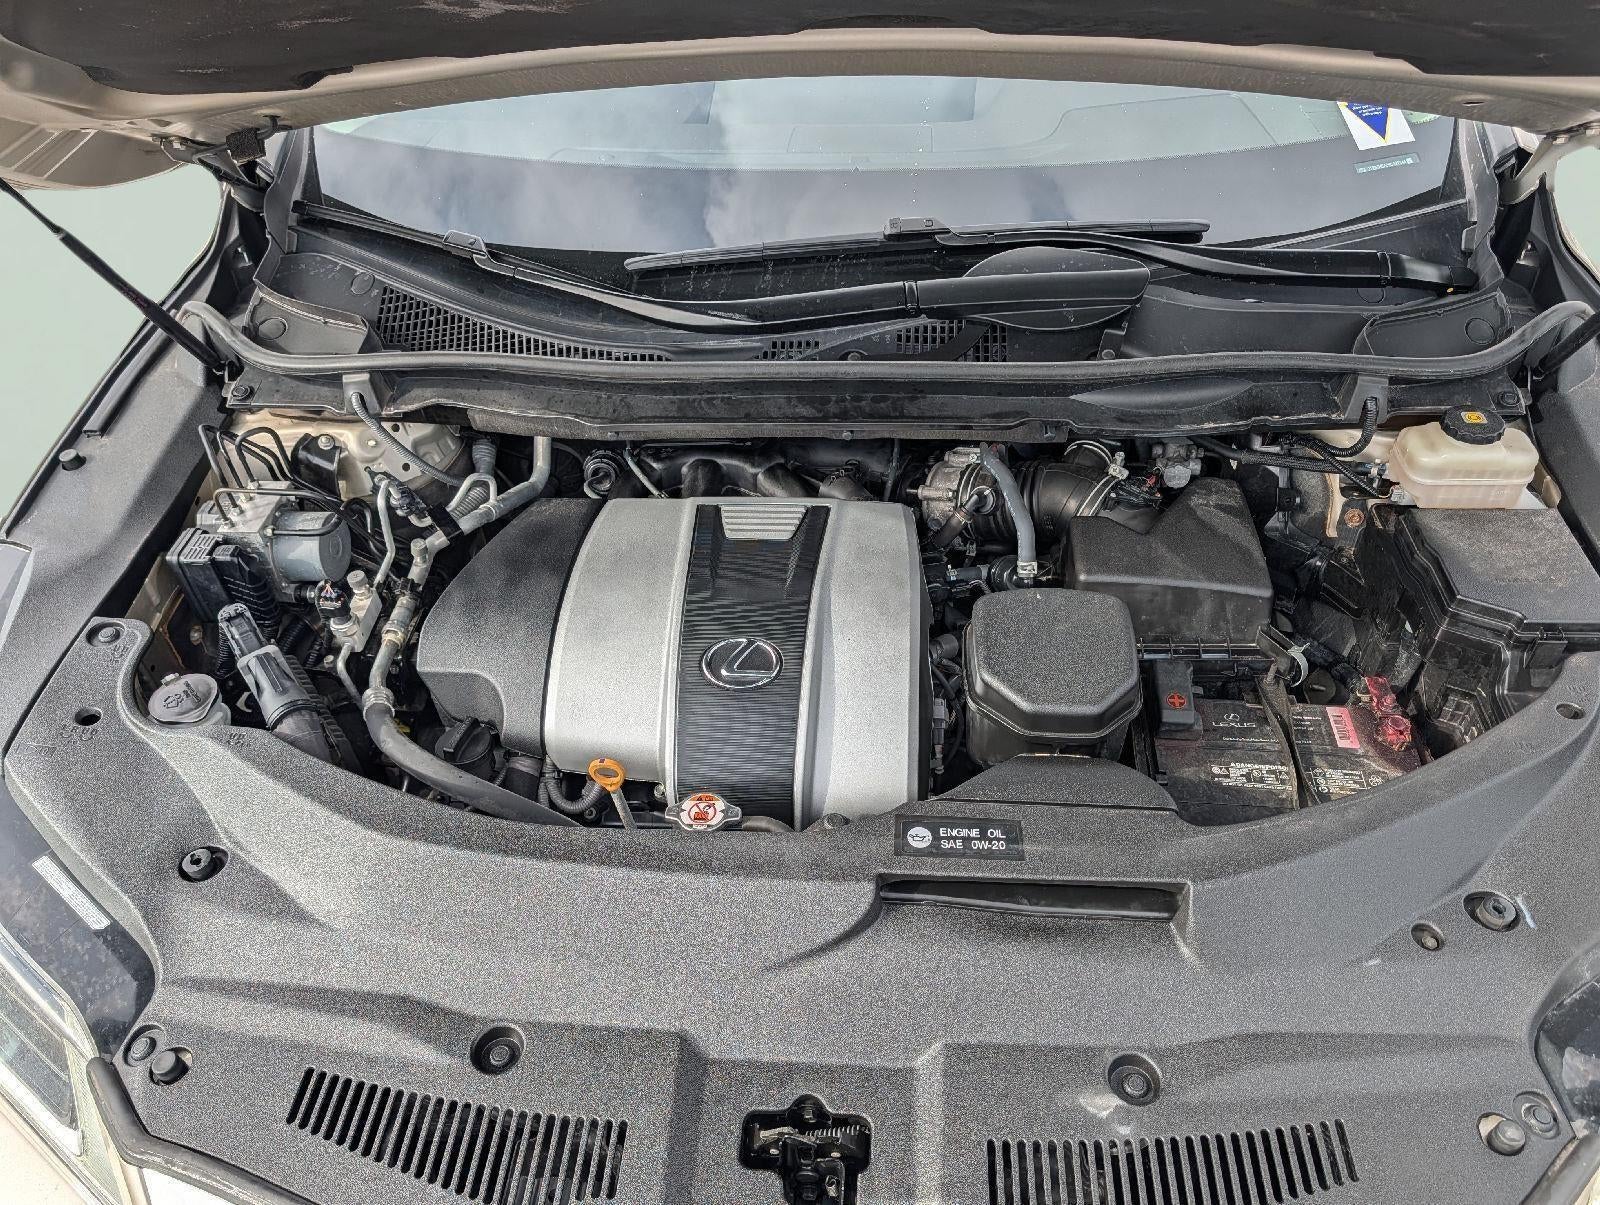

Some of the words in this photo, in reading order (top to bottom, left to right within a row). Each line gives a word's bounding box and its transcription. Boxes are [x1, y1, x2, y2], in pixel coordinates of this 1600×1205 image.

[939, 827, 981, 838] ENGINE
[987, 829, 1006, 839] OIL
[940, 839, 964, 849] SAE
[971, 841, 1006, 850] 0W-20
